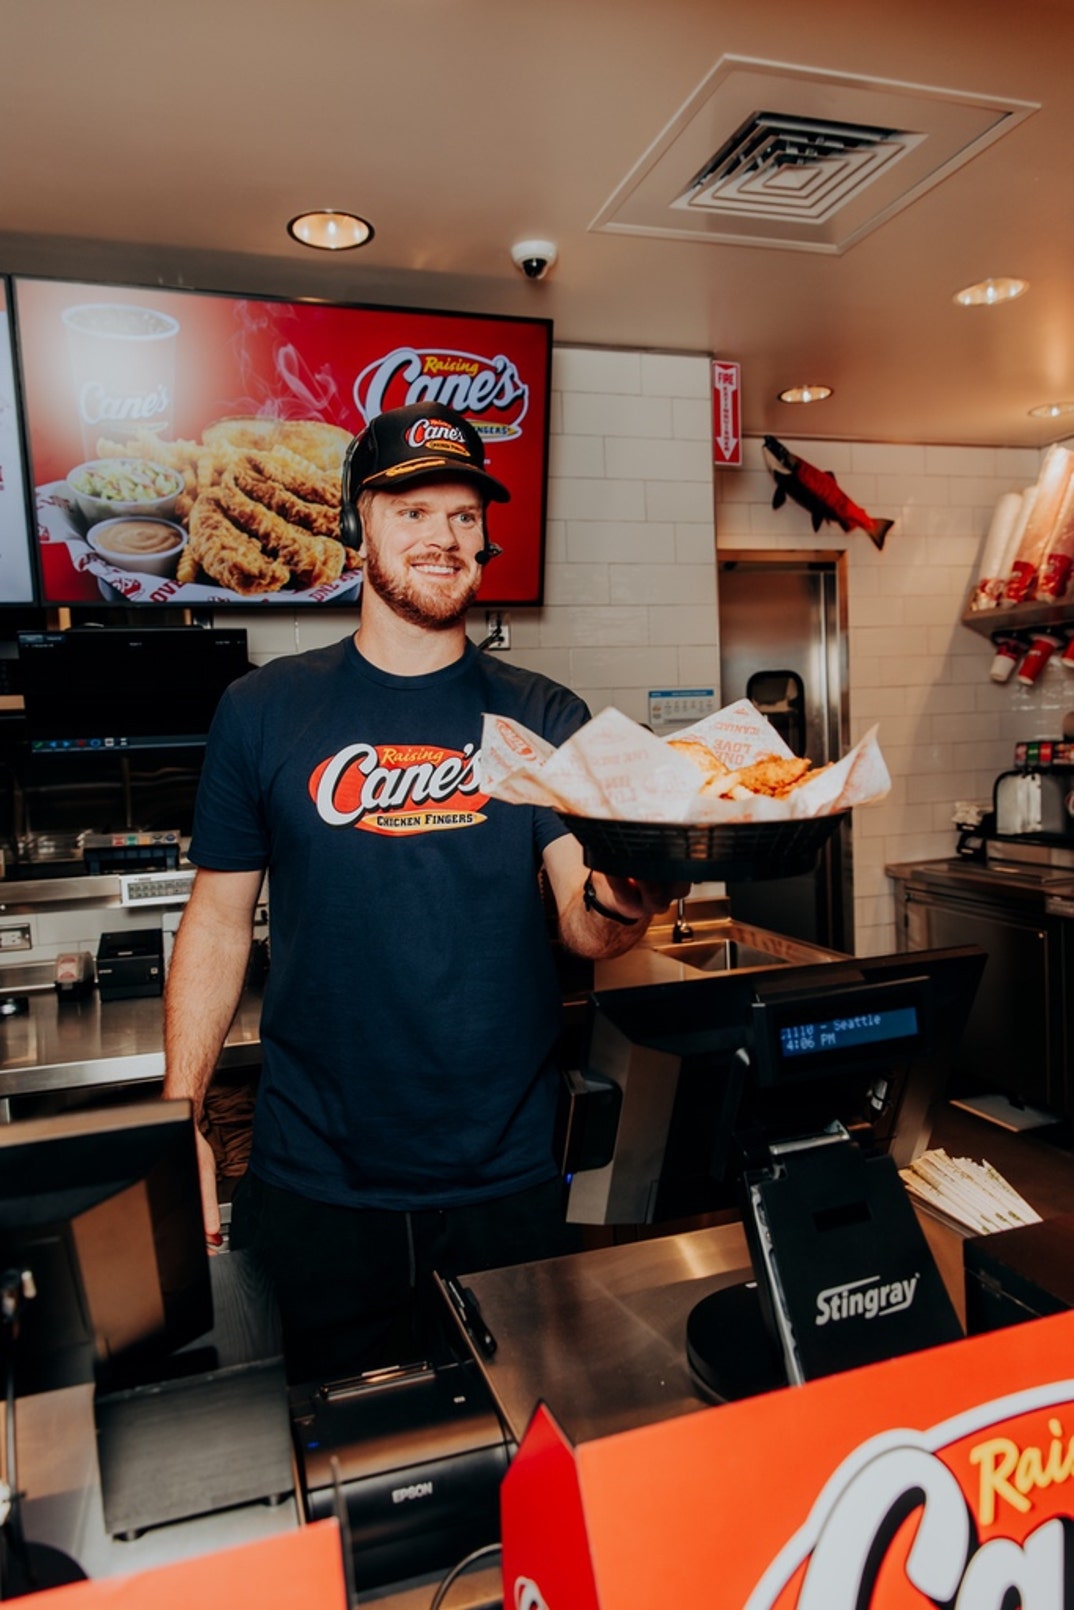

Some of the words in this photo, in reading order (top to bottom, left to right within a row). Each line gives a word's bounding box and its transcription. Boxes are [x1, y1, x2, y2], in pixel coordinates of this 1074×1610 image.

[423, 356, 479, 377] Raising
[365, 349, 523, 421] Cane's
[408, 418, 466, 448] Cane's
[381, 748, 444, 764] Raising
[317, 743, 482, 825] Cane's
[376, 815, 421, 827] CHICKEN
[425, 813, 473, 825] FINGERS
[833, 1014, 881, 1032] Seattle
[820, 1033, 836, 1046] PM
[815, 1275, 917, 1325] Stingray
[969, 1418, 1074, 1526] Rai
[392, 1481, 433, 1504] EPSON
